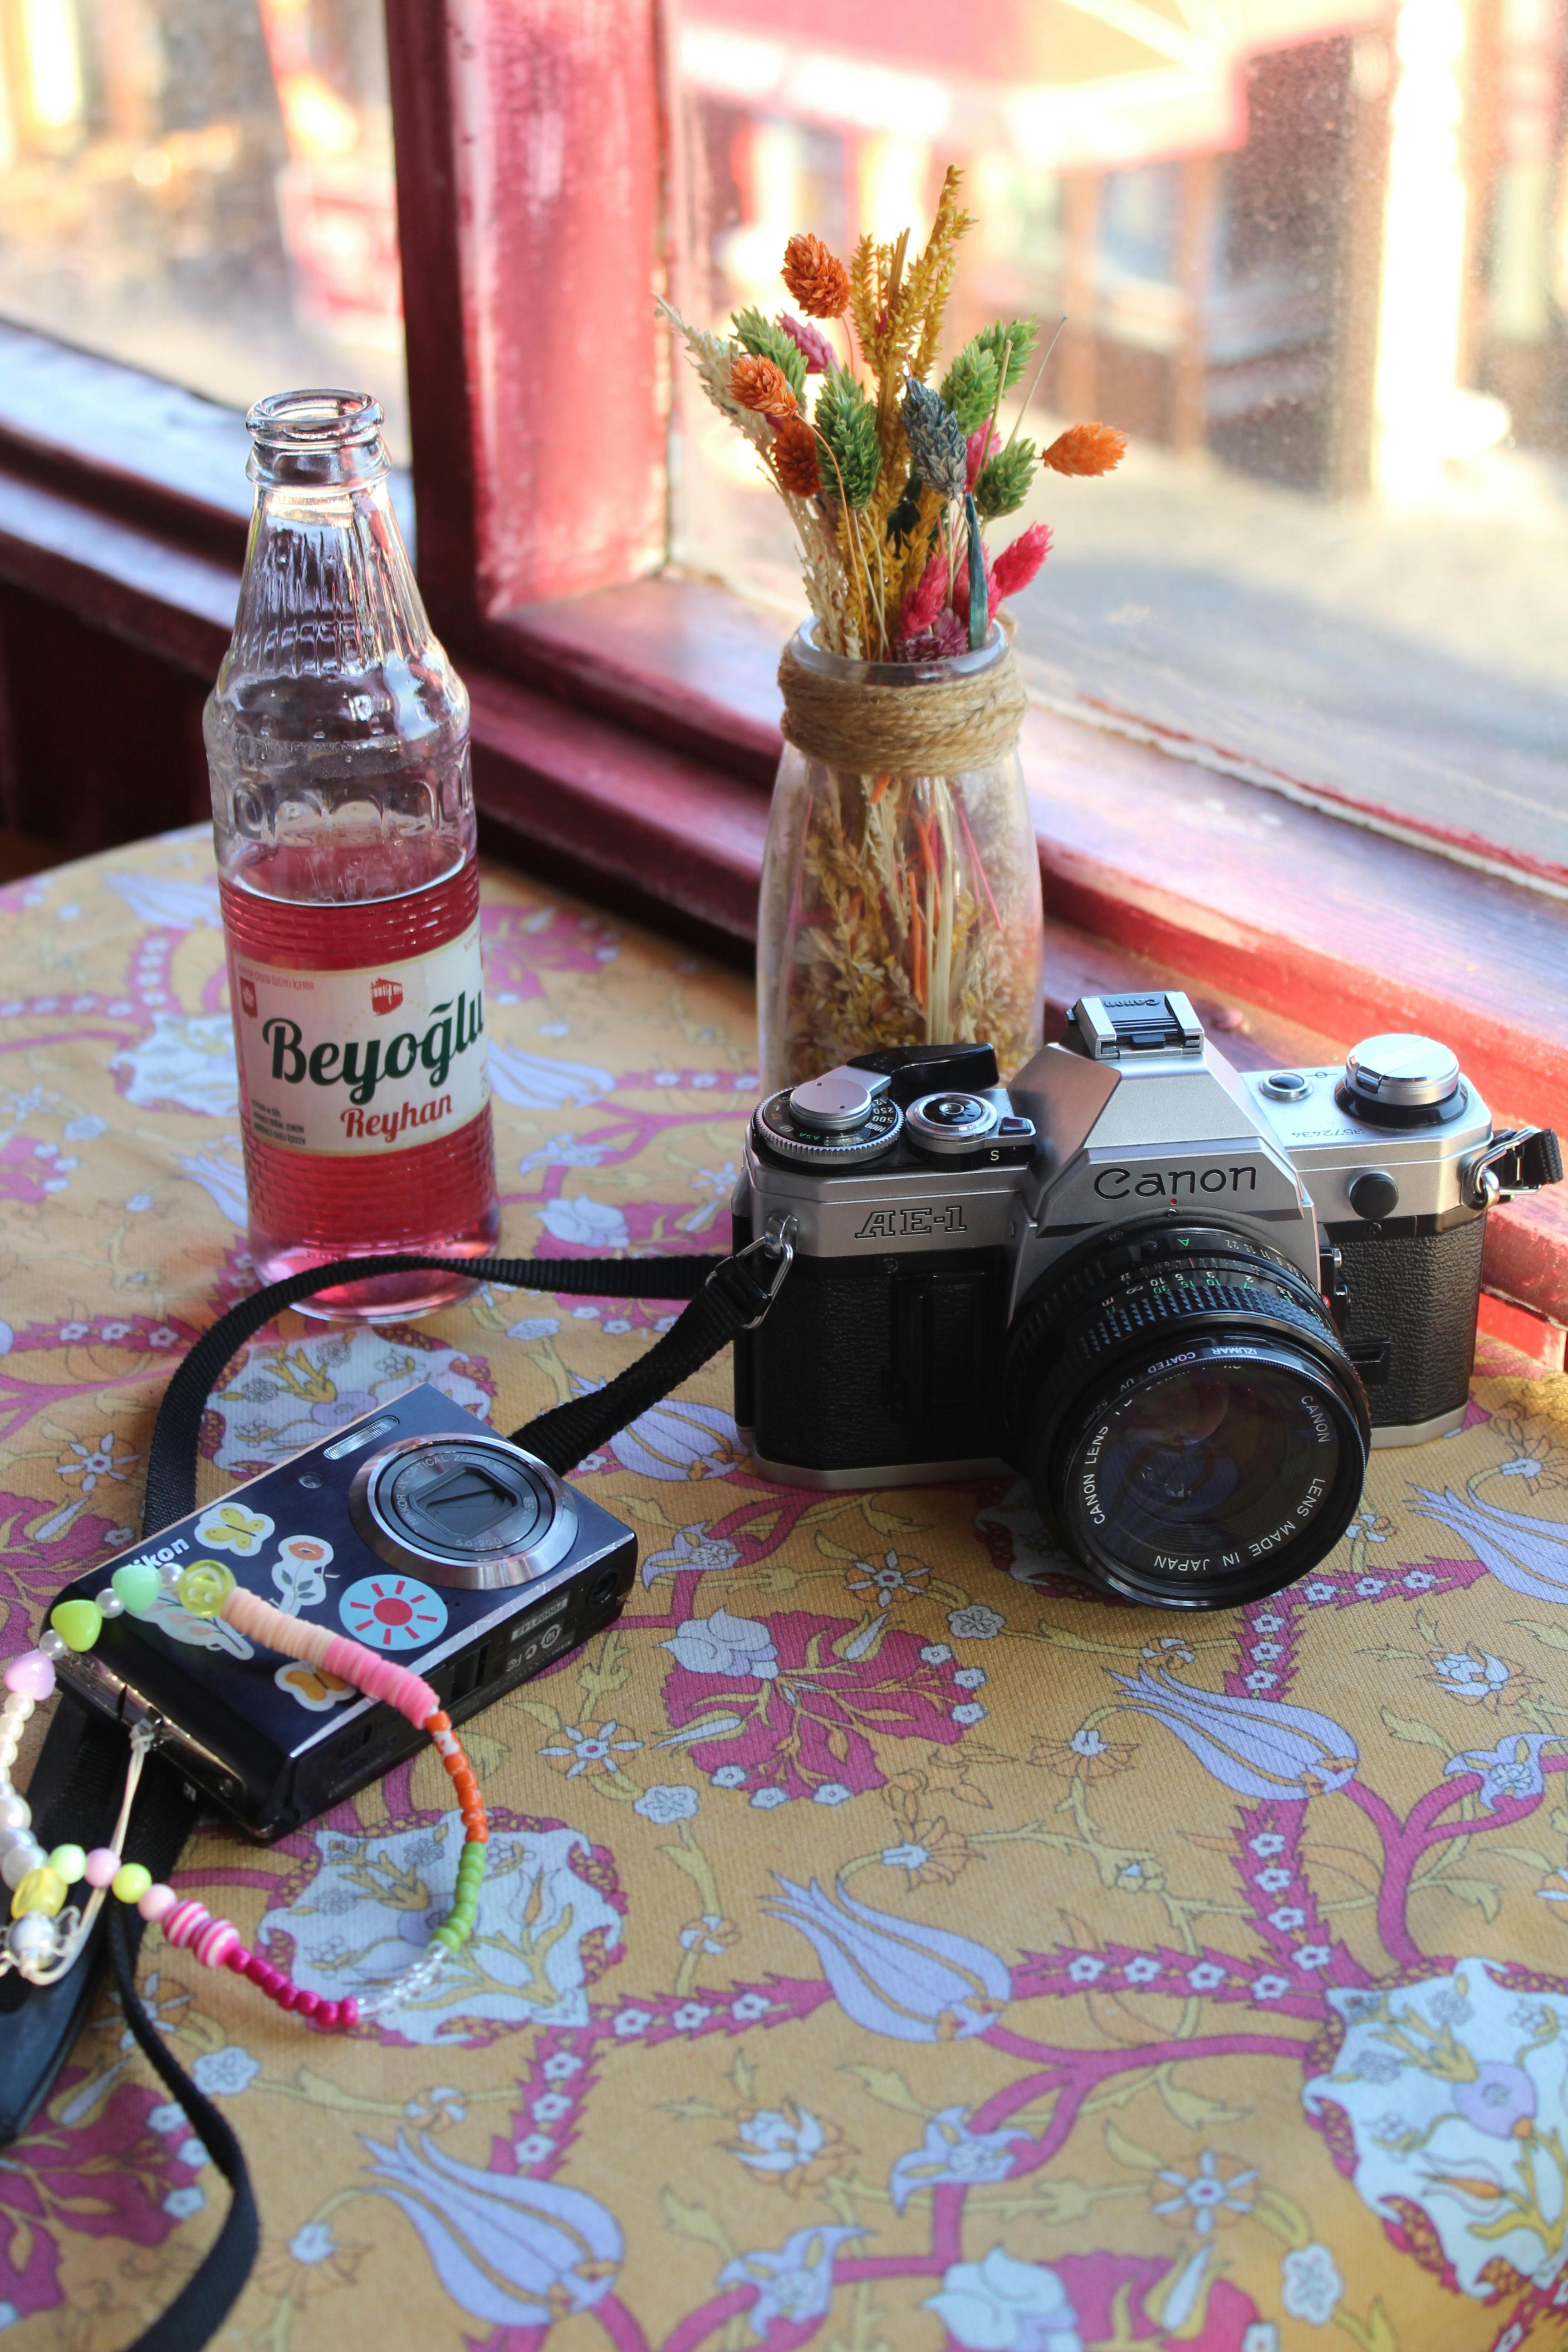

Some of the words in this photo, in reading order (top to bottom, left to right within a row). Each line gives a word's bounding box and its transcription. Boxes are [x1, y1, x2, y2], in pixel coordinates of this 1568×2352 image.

[262, 989, 484, 1105] Beyoğlu
[340, 1094, 452, 1143] Reyhan
[864, 1122, 887, 1132] 1000
[990, 1150, 999, 1161] S
[1094, 1166, 1257, 1200] Canon
[854, 1205, 967, 1240] AE-1
[1177, 1238, 1190, 1246] A
[1225, 1240, 1239, 1249] 22
[1260, 1249, 1271, 1259] 11
[1120, 1272, 1131, 1281] 22
[1150, 1277, 1165, 1286] 10
[1153, 1285, 1170, 1294] 30
[1181, 1280, 1196, 1289] 15
[1102, 1297, 1114, 1307] m
[1148, 1352, 1196, 1373] COATED
[1120, 1378, 1134, 1392] UV
[1301, 1396, 1330, 1442] CANON
[1085, 1426, 1108, 1464] LENS
[405, 1455, 449, 1478] OPTICAL
[454, 1454, 490, 1466] ZOOM
[400, 1481, 408, 1491] 4X
[1083, 1474, 1105, 1524] CANON
[1297, 1478, 1326, 1516] LENS
[397, 1494, 420, 1526] NIKKOR
[1249, 1520, 1296, 1557] MADE
[127, 1539, 190, 1569] kon
[1223, 1552, 1240, 1567] IN
[1154, 1555, 1210, 1571] JAPAN
